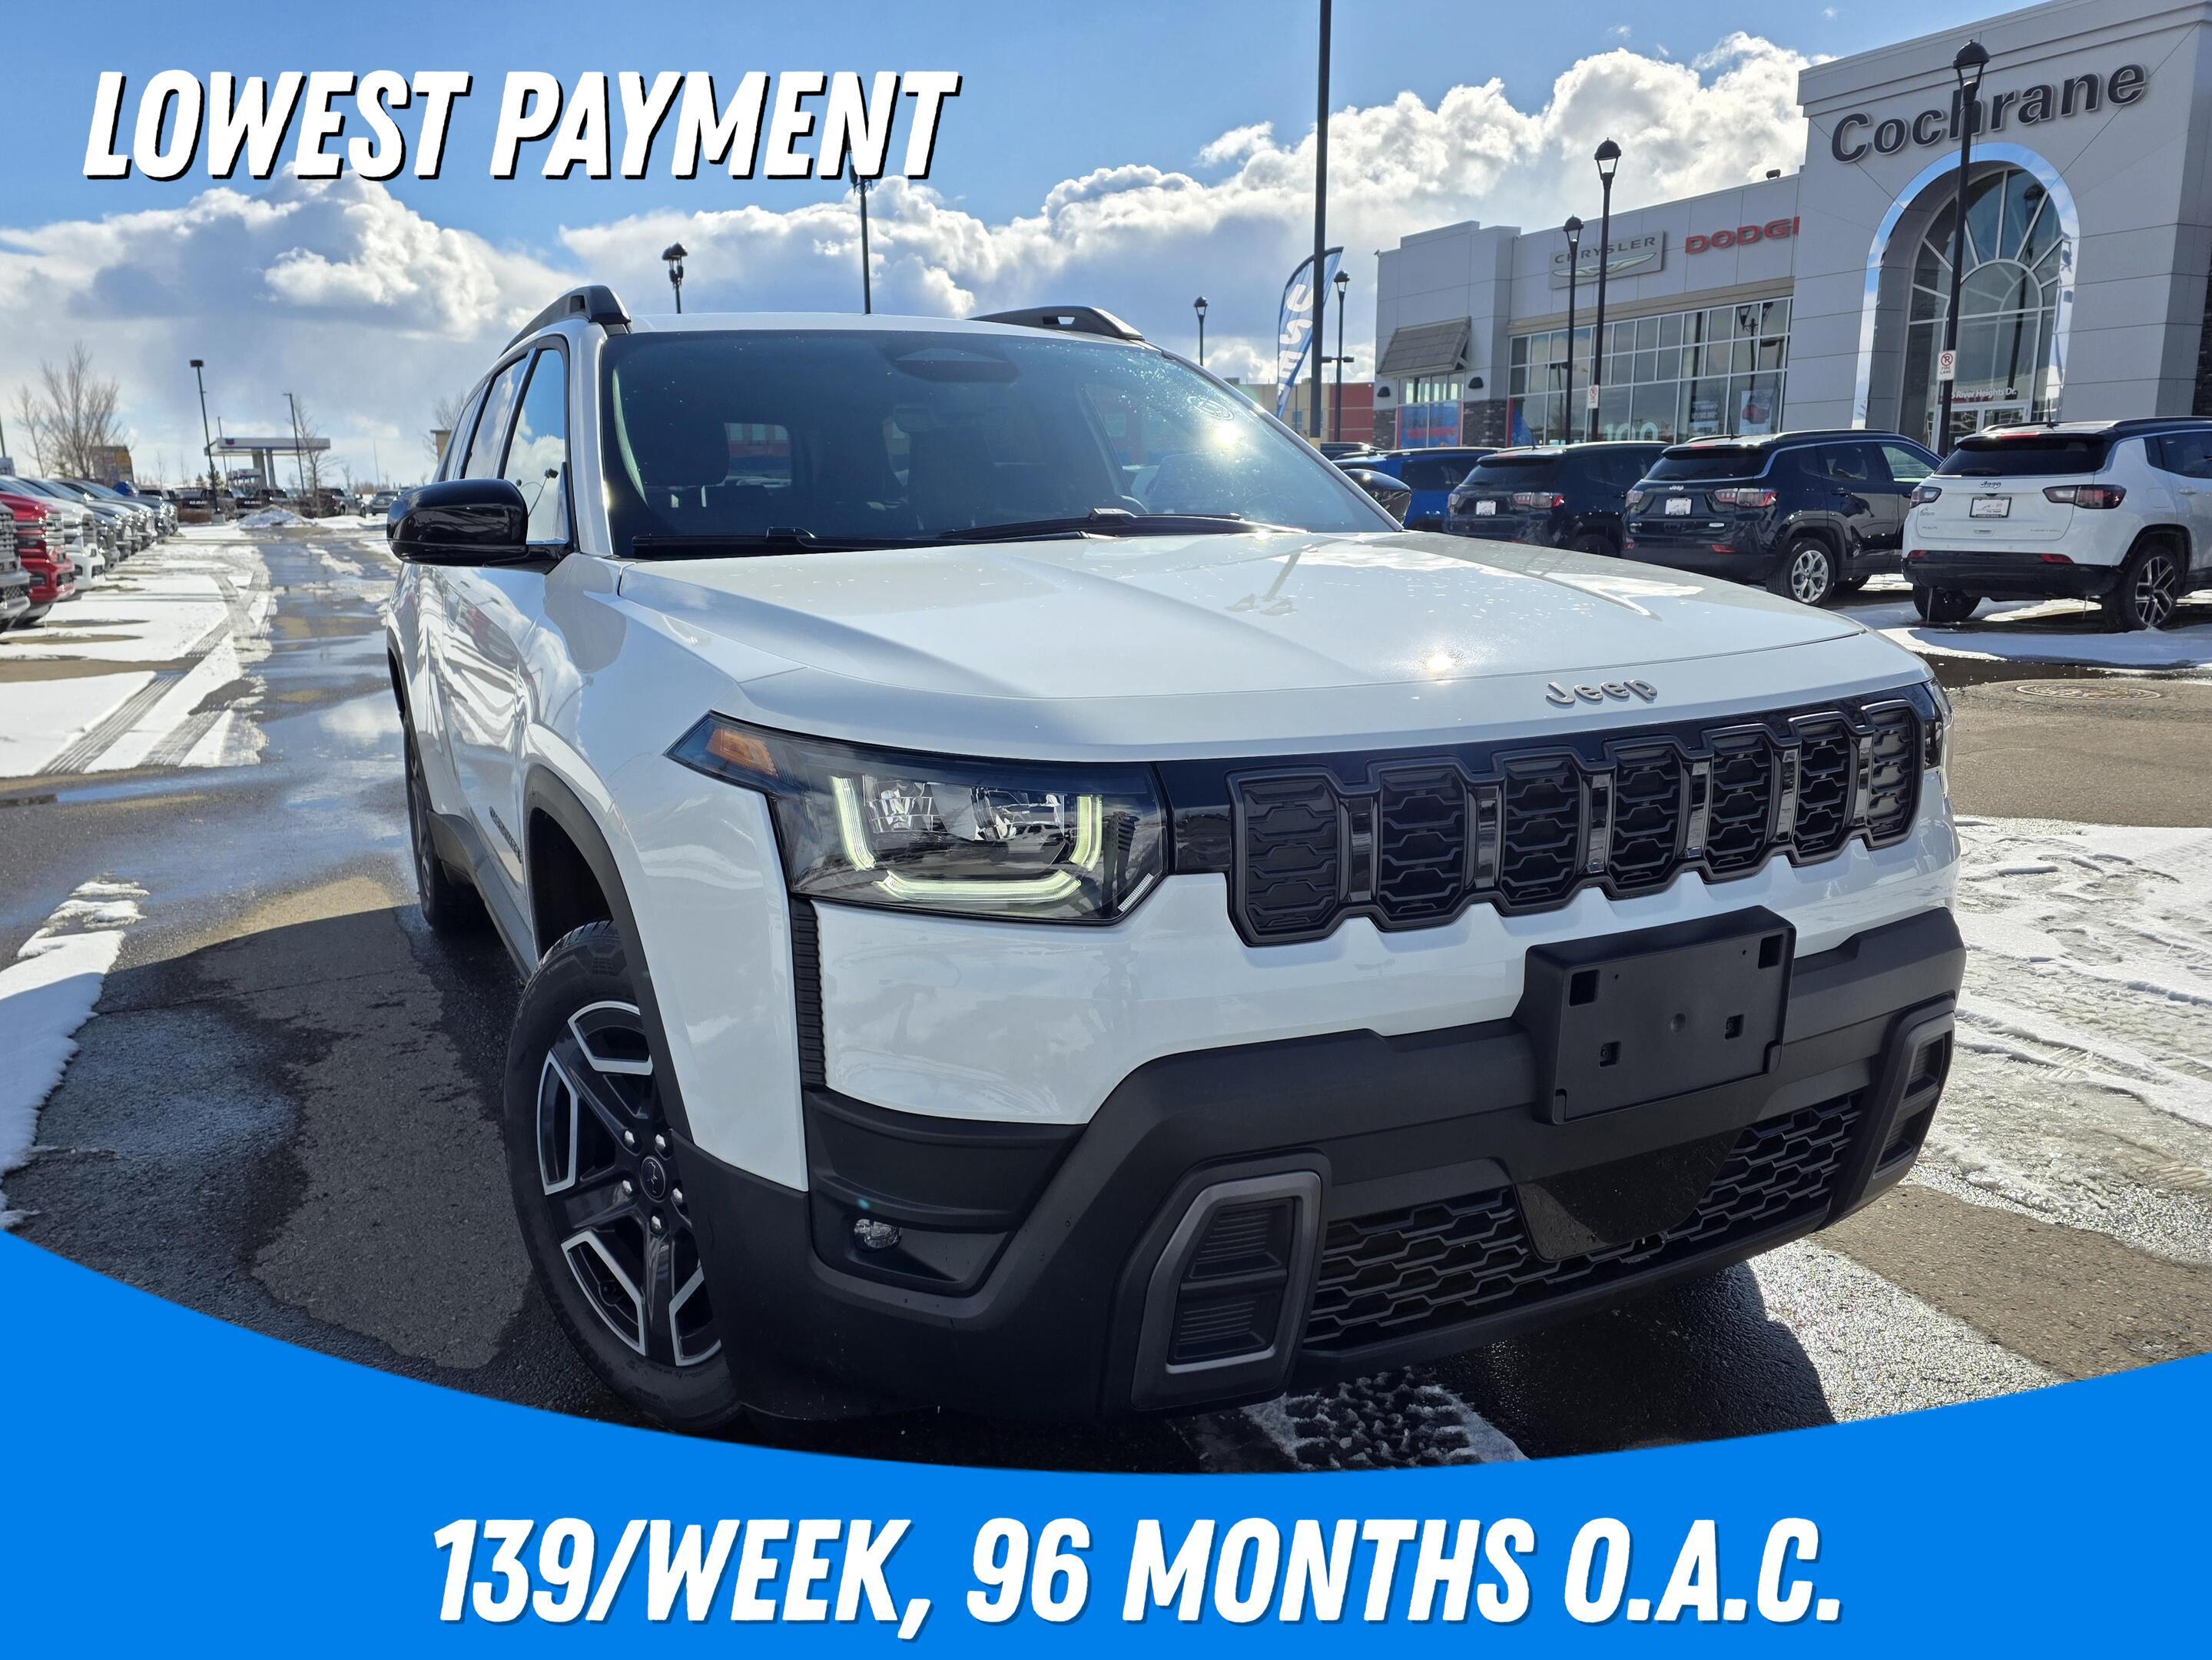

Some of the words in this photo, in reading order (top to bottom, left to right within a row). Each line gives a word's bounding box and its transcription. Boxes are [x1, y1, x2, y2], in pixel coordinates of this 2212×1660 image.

[1831, 62, 2149, 164] Cochrane
[1955, 390, 1975, 399] River
[1975, 387, 2005, 398] Heights
[1545, 679, 1658, 706] Jeep
